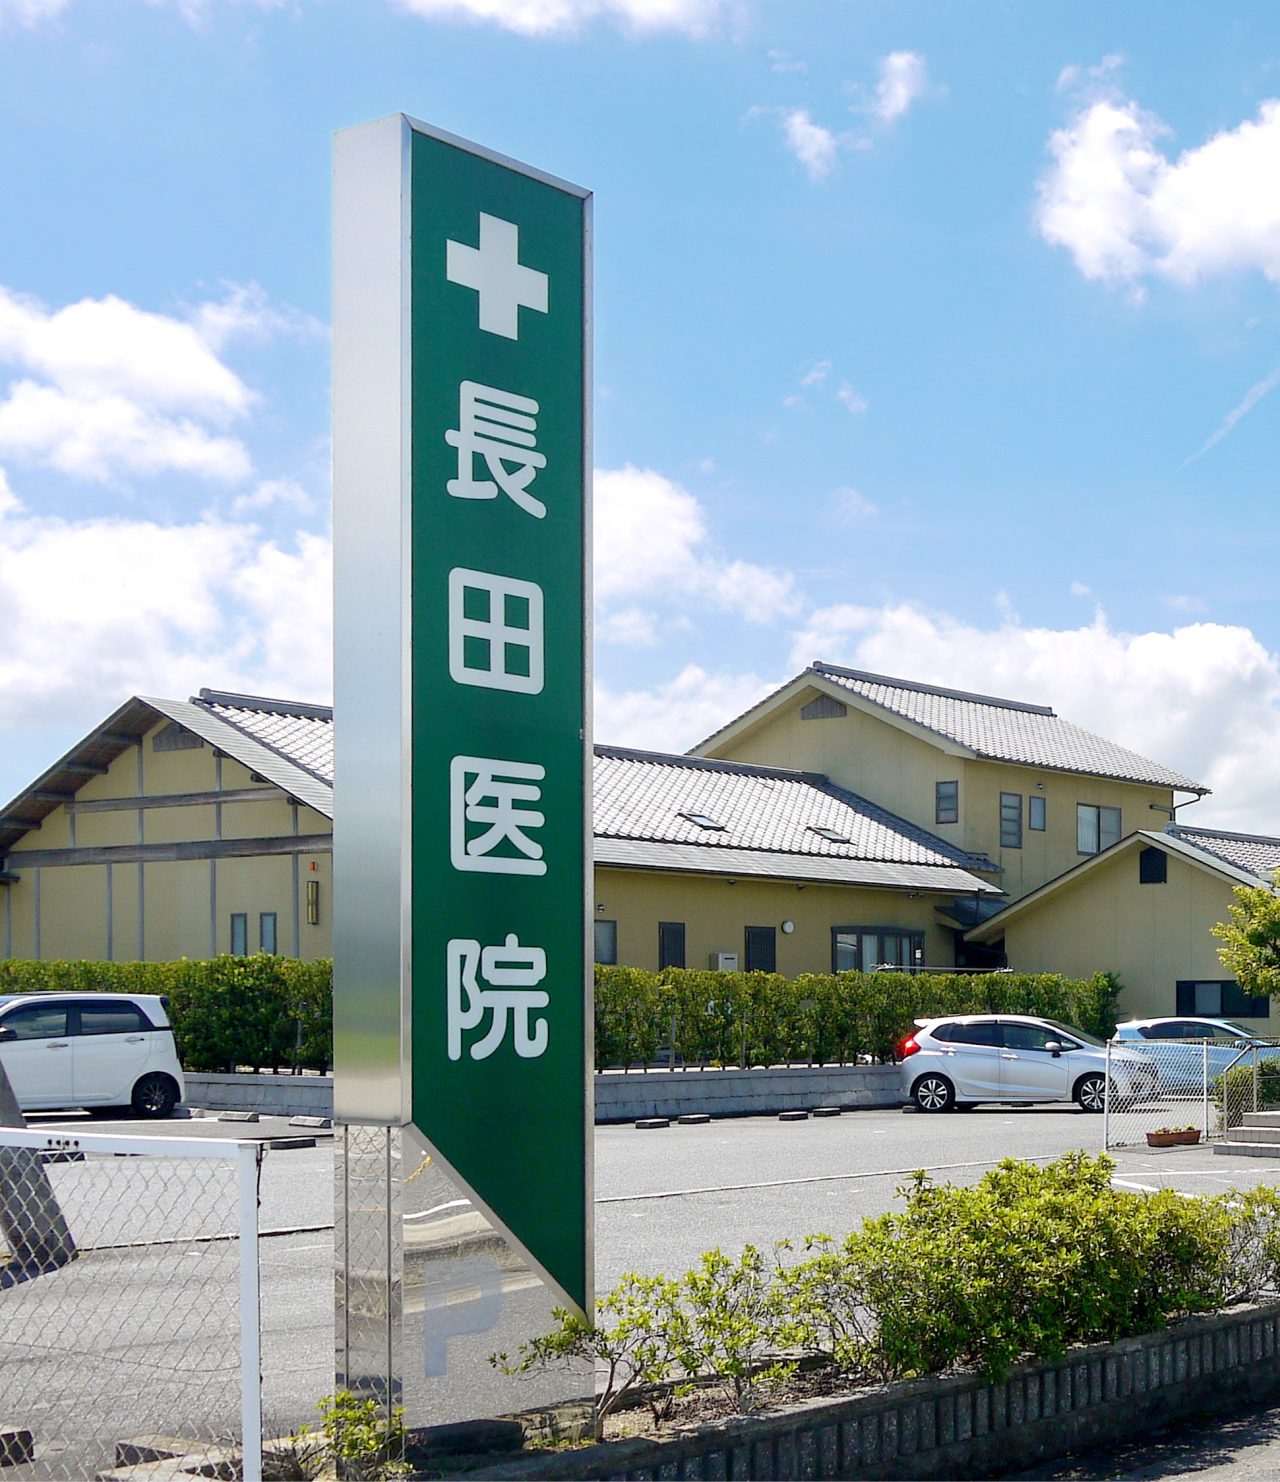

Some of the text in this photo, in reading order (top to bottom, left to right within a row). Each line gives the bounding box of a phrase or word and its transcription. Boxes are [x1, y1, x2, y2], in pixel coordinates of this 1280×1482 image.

[445, 380, 549, 1061] 長田医院
[424, 1256, 503, 1377] P
